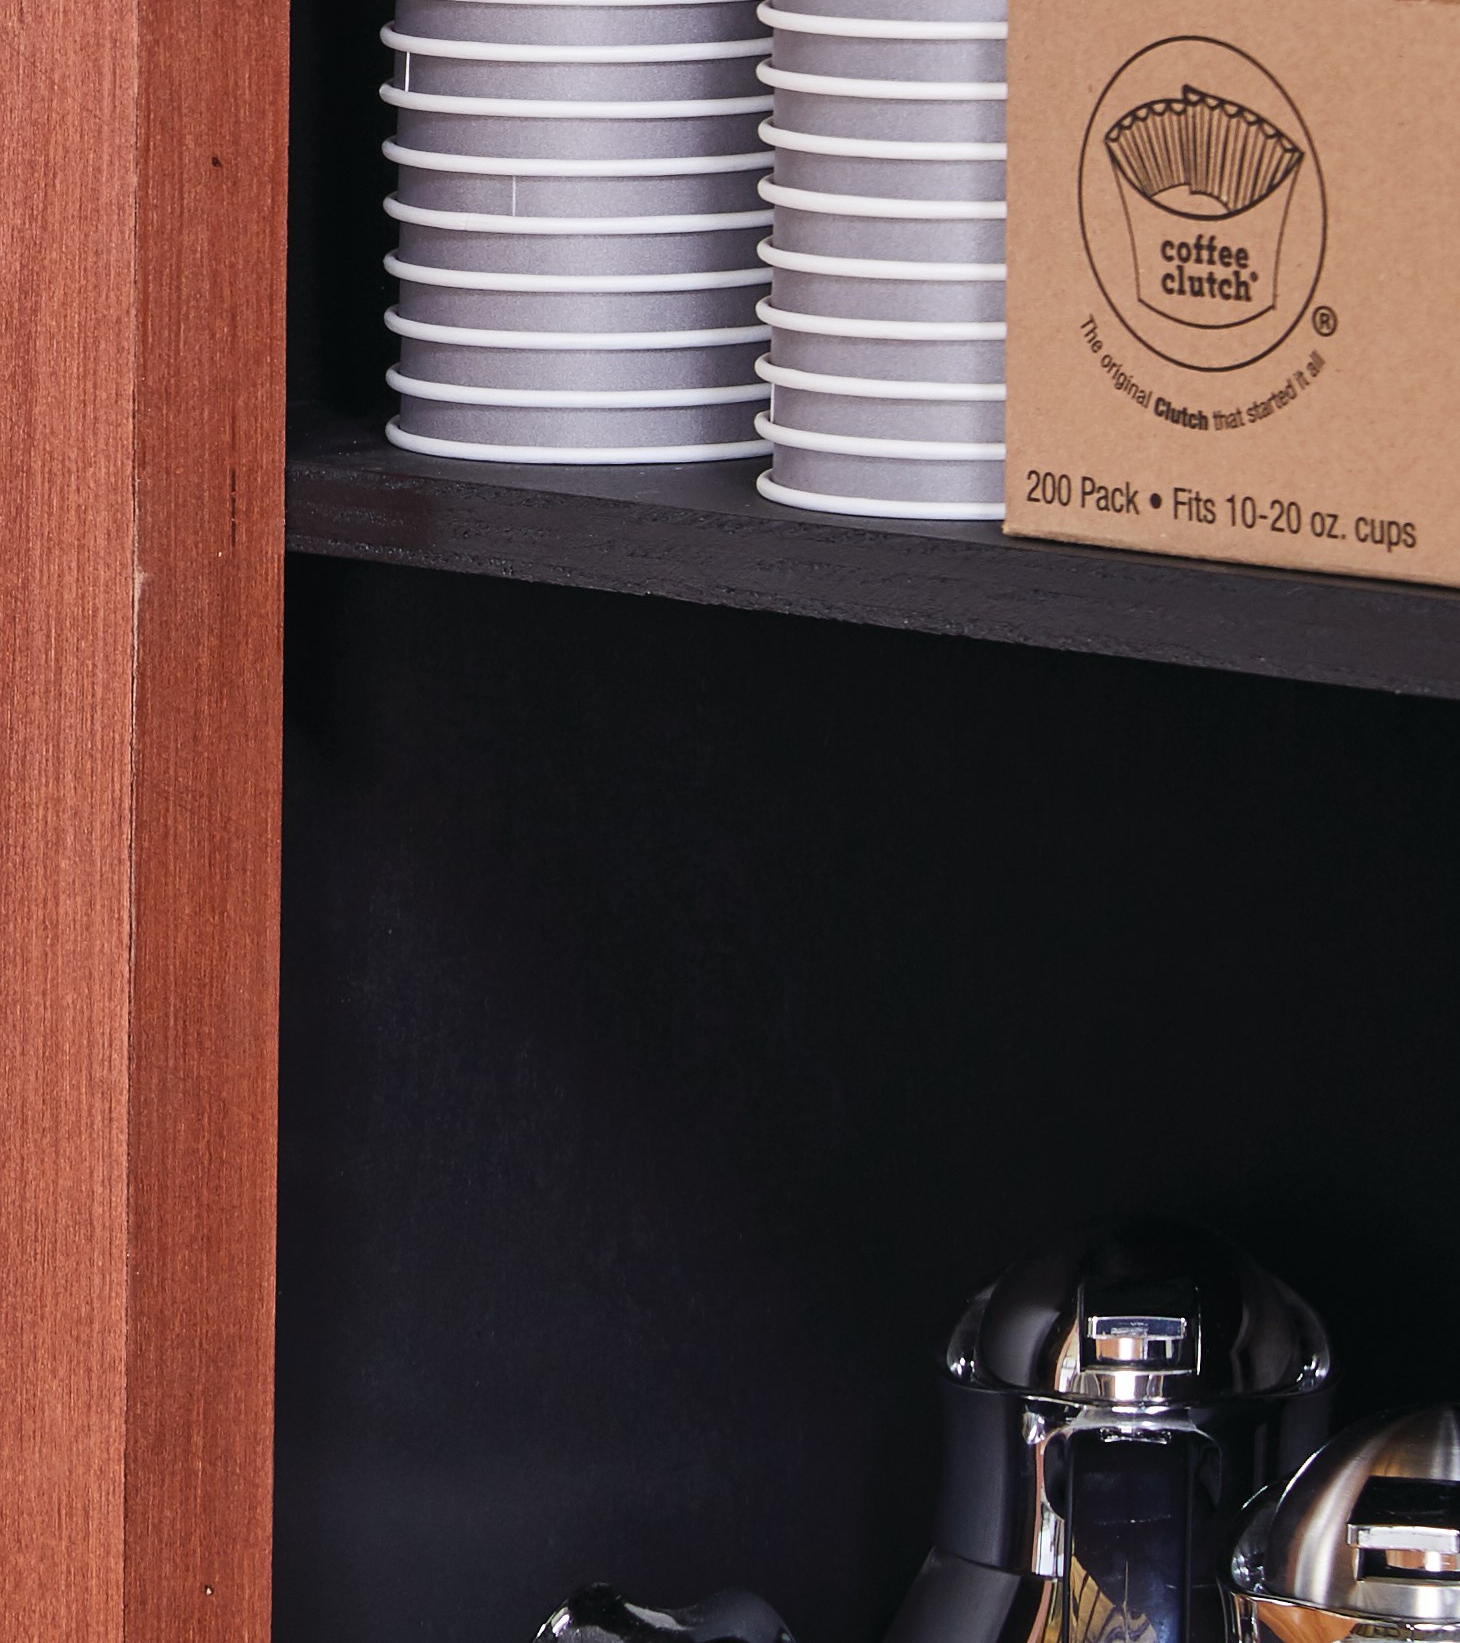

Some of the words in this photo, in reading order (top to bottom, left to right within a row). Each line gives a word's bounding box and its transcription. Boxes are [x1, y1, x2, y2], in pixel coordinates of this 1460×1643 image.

[1160, 233, 1249, 269] coffee
[1081, 314, 1104, 353] The
[1100, 353, 1154, 409] original
[1153, 396, 1209, 431] Clutch
[1212, 407, 1245, 431] that
[1246, 379, 1298, 424] started
[1292, 369, 1311, 390] it
[1306, 348, 1326, 378] all
[1026, 469, 1072, 507] 200
[1081, 475, 1140, 516] Pack
[1172, 486, 1217, 525] Fits
[1226, 493, 1301, 535] 10-20
[1310, 511, 1347, 540] oz.
[1355, 515, 1418, 554] cups
